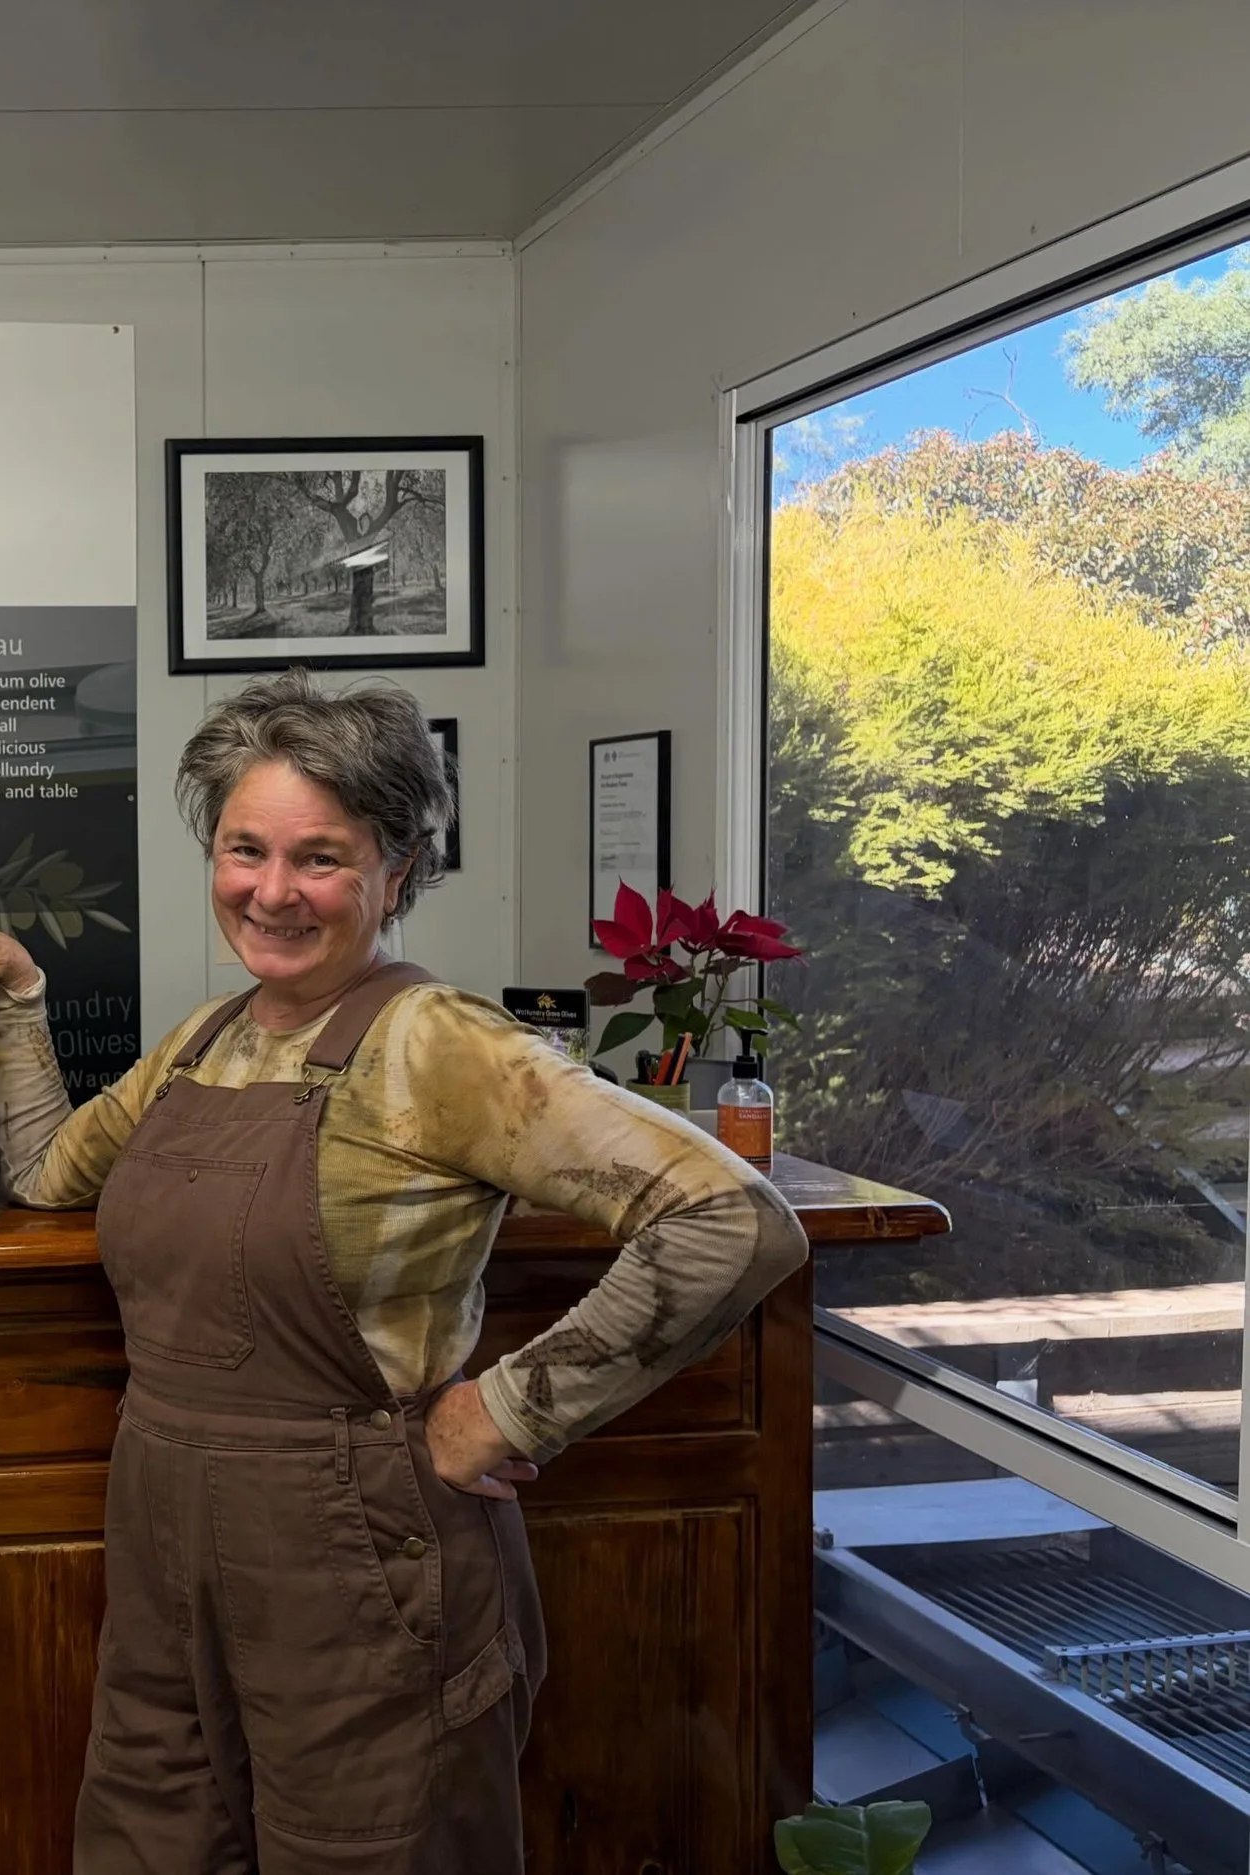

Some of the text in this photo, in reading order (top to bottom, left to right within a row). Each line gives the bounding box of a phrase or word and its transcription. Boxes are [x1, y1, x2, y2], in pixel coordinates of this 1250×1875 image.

[29, 673, 65, 688] olive
[0, 718, 17, 732] all
[5, 785, 34, 798] and
[39, 784, 78, 798] table
[47, 990, 133, 1022] undry
[57, 1029, 136, 1057] Olives
